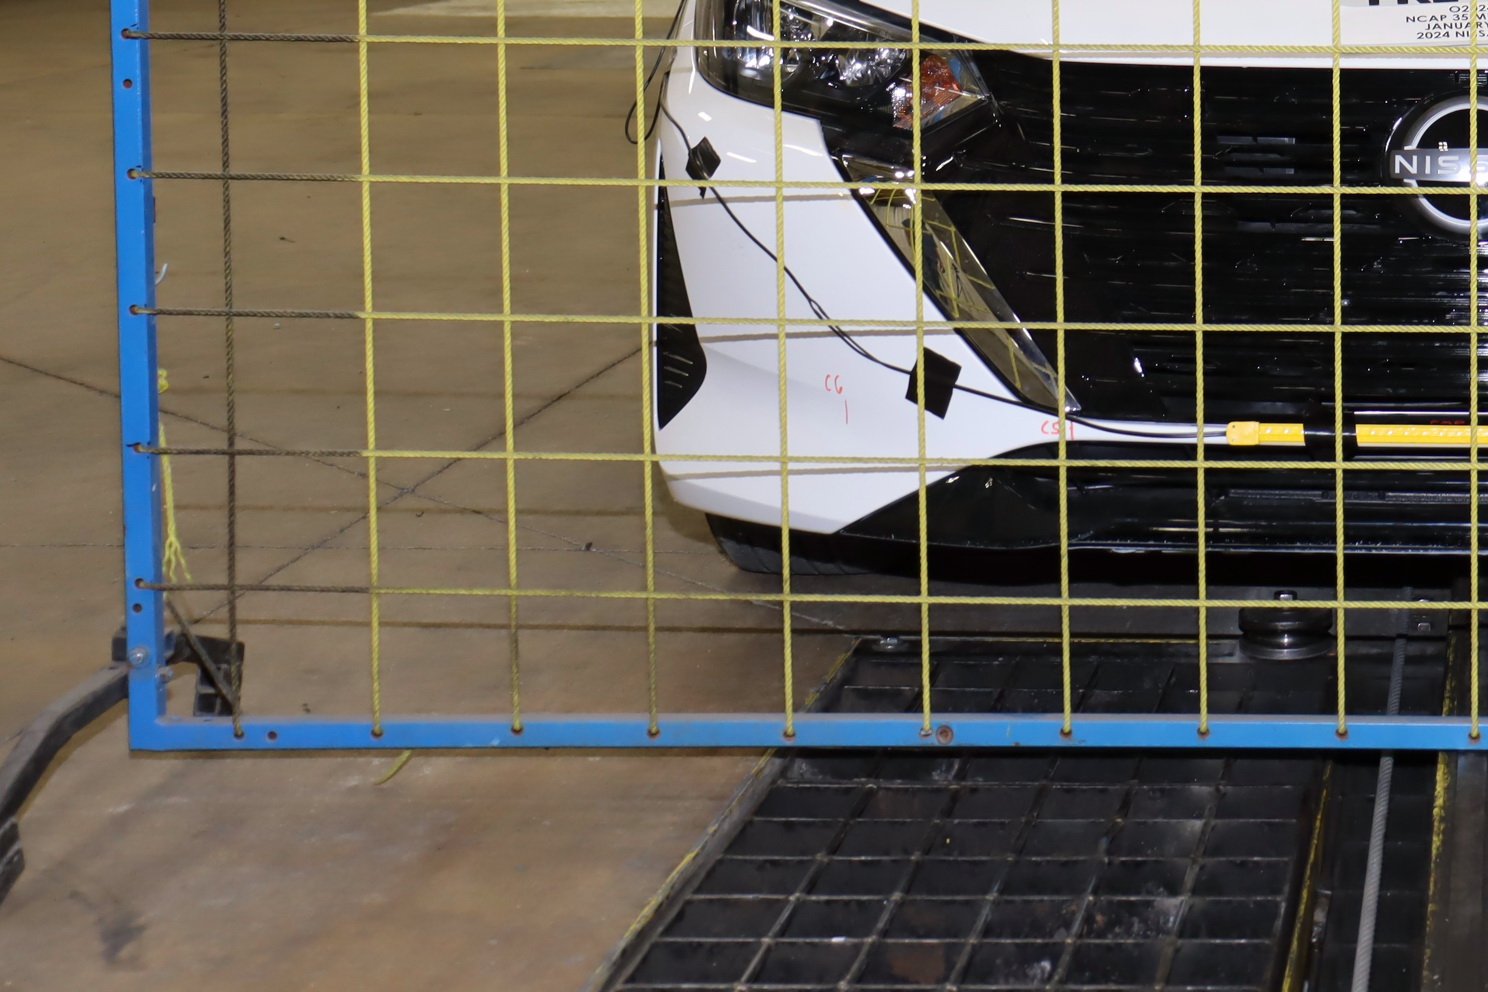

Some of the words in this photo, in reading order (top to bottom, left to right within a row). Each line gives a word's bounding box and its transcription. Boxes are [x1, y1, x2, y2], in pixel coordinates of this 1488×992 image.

[1405, 14, 1447, 23] NCAP
[1452, 13, 1469, 22] 35
[1416, 31, 1450, 40] 2024
[824, 374, 843, 395] C6
